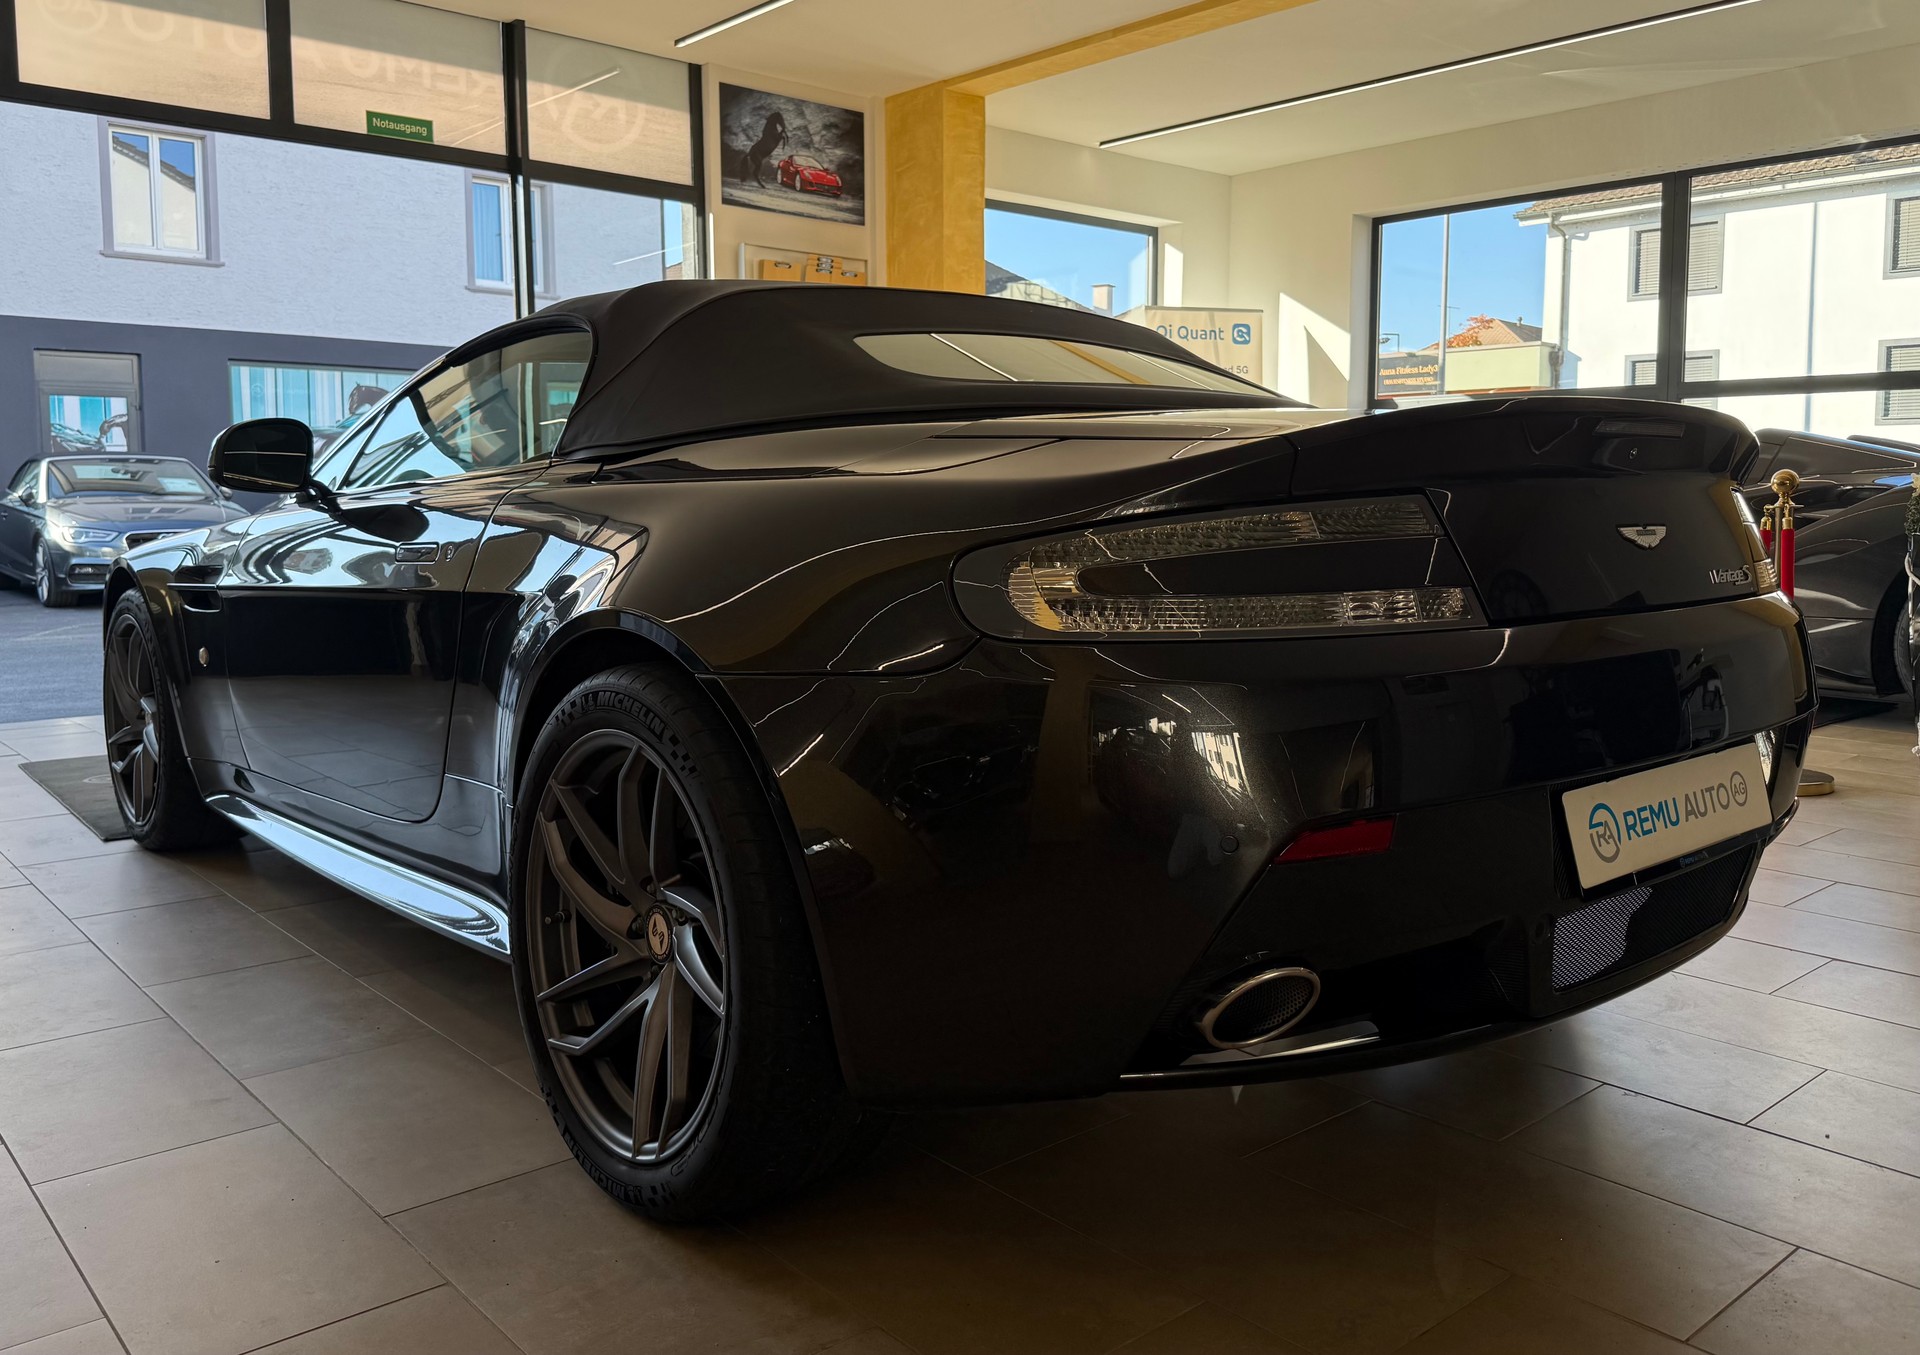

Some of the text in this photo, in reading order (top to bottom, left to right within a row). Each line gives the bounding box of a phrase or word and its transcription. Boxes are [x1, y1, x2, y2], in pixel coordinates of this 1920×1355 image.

[372, 117, 428, 137] Notausgang
[1177, 325, 1225, 342] Quant
[1236, 365, 1249, 375] 5G
[597, 691, 666, 735] MICHELIN
[1623, 797, 1680, 841] REMU
[1684, 783, 1730, 822] AUTO
[1734, 781, 1746, 797] AG
